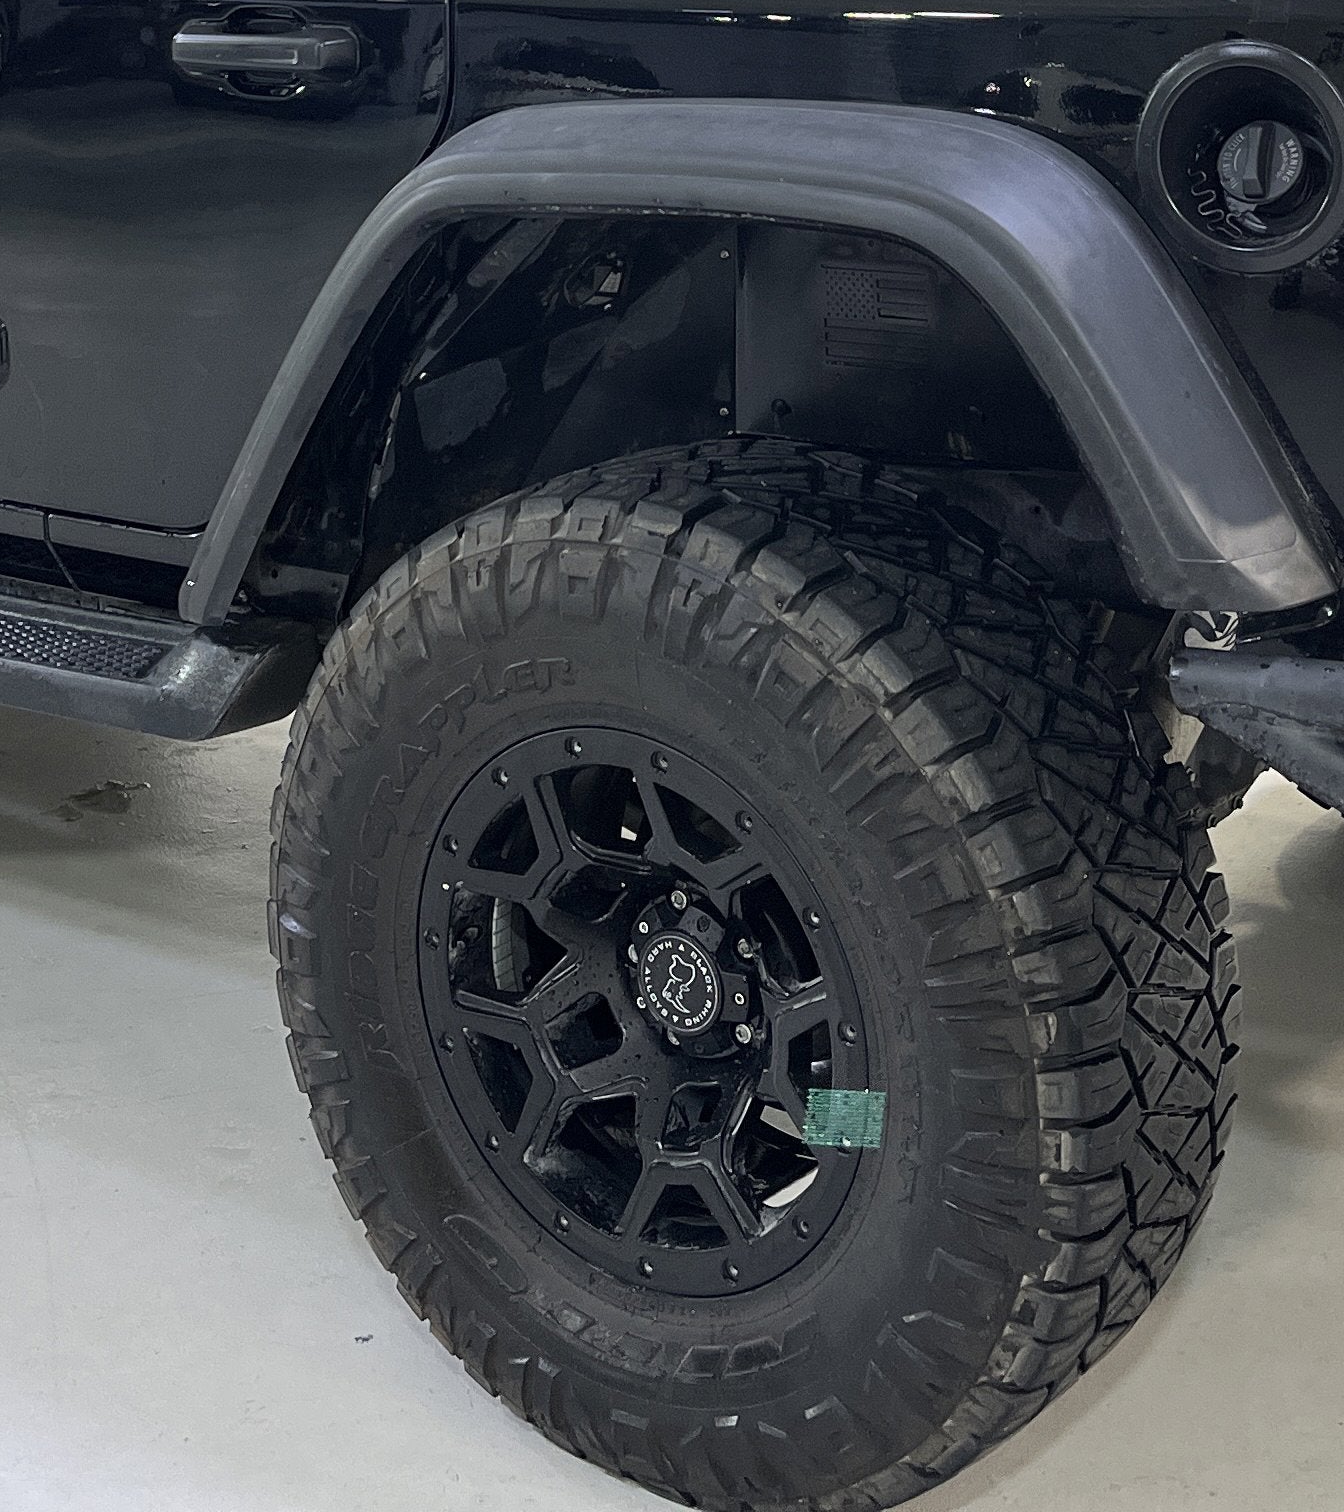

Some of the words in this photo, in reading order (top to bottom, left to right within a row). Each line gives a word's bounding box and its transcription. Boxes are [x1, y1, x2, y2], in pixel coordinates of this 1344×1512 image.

[1281, 138, 1299, 183] WARNING
[647, 941, 673, 963] HARD
[690, 950, 713, 993] BLACK
[644, 966, 669, 1018] ALLOYS
[684, 999, 712, 1027] RHINO
